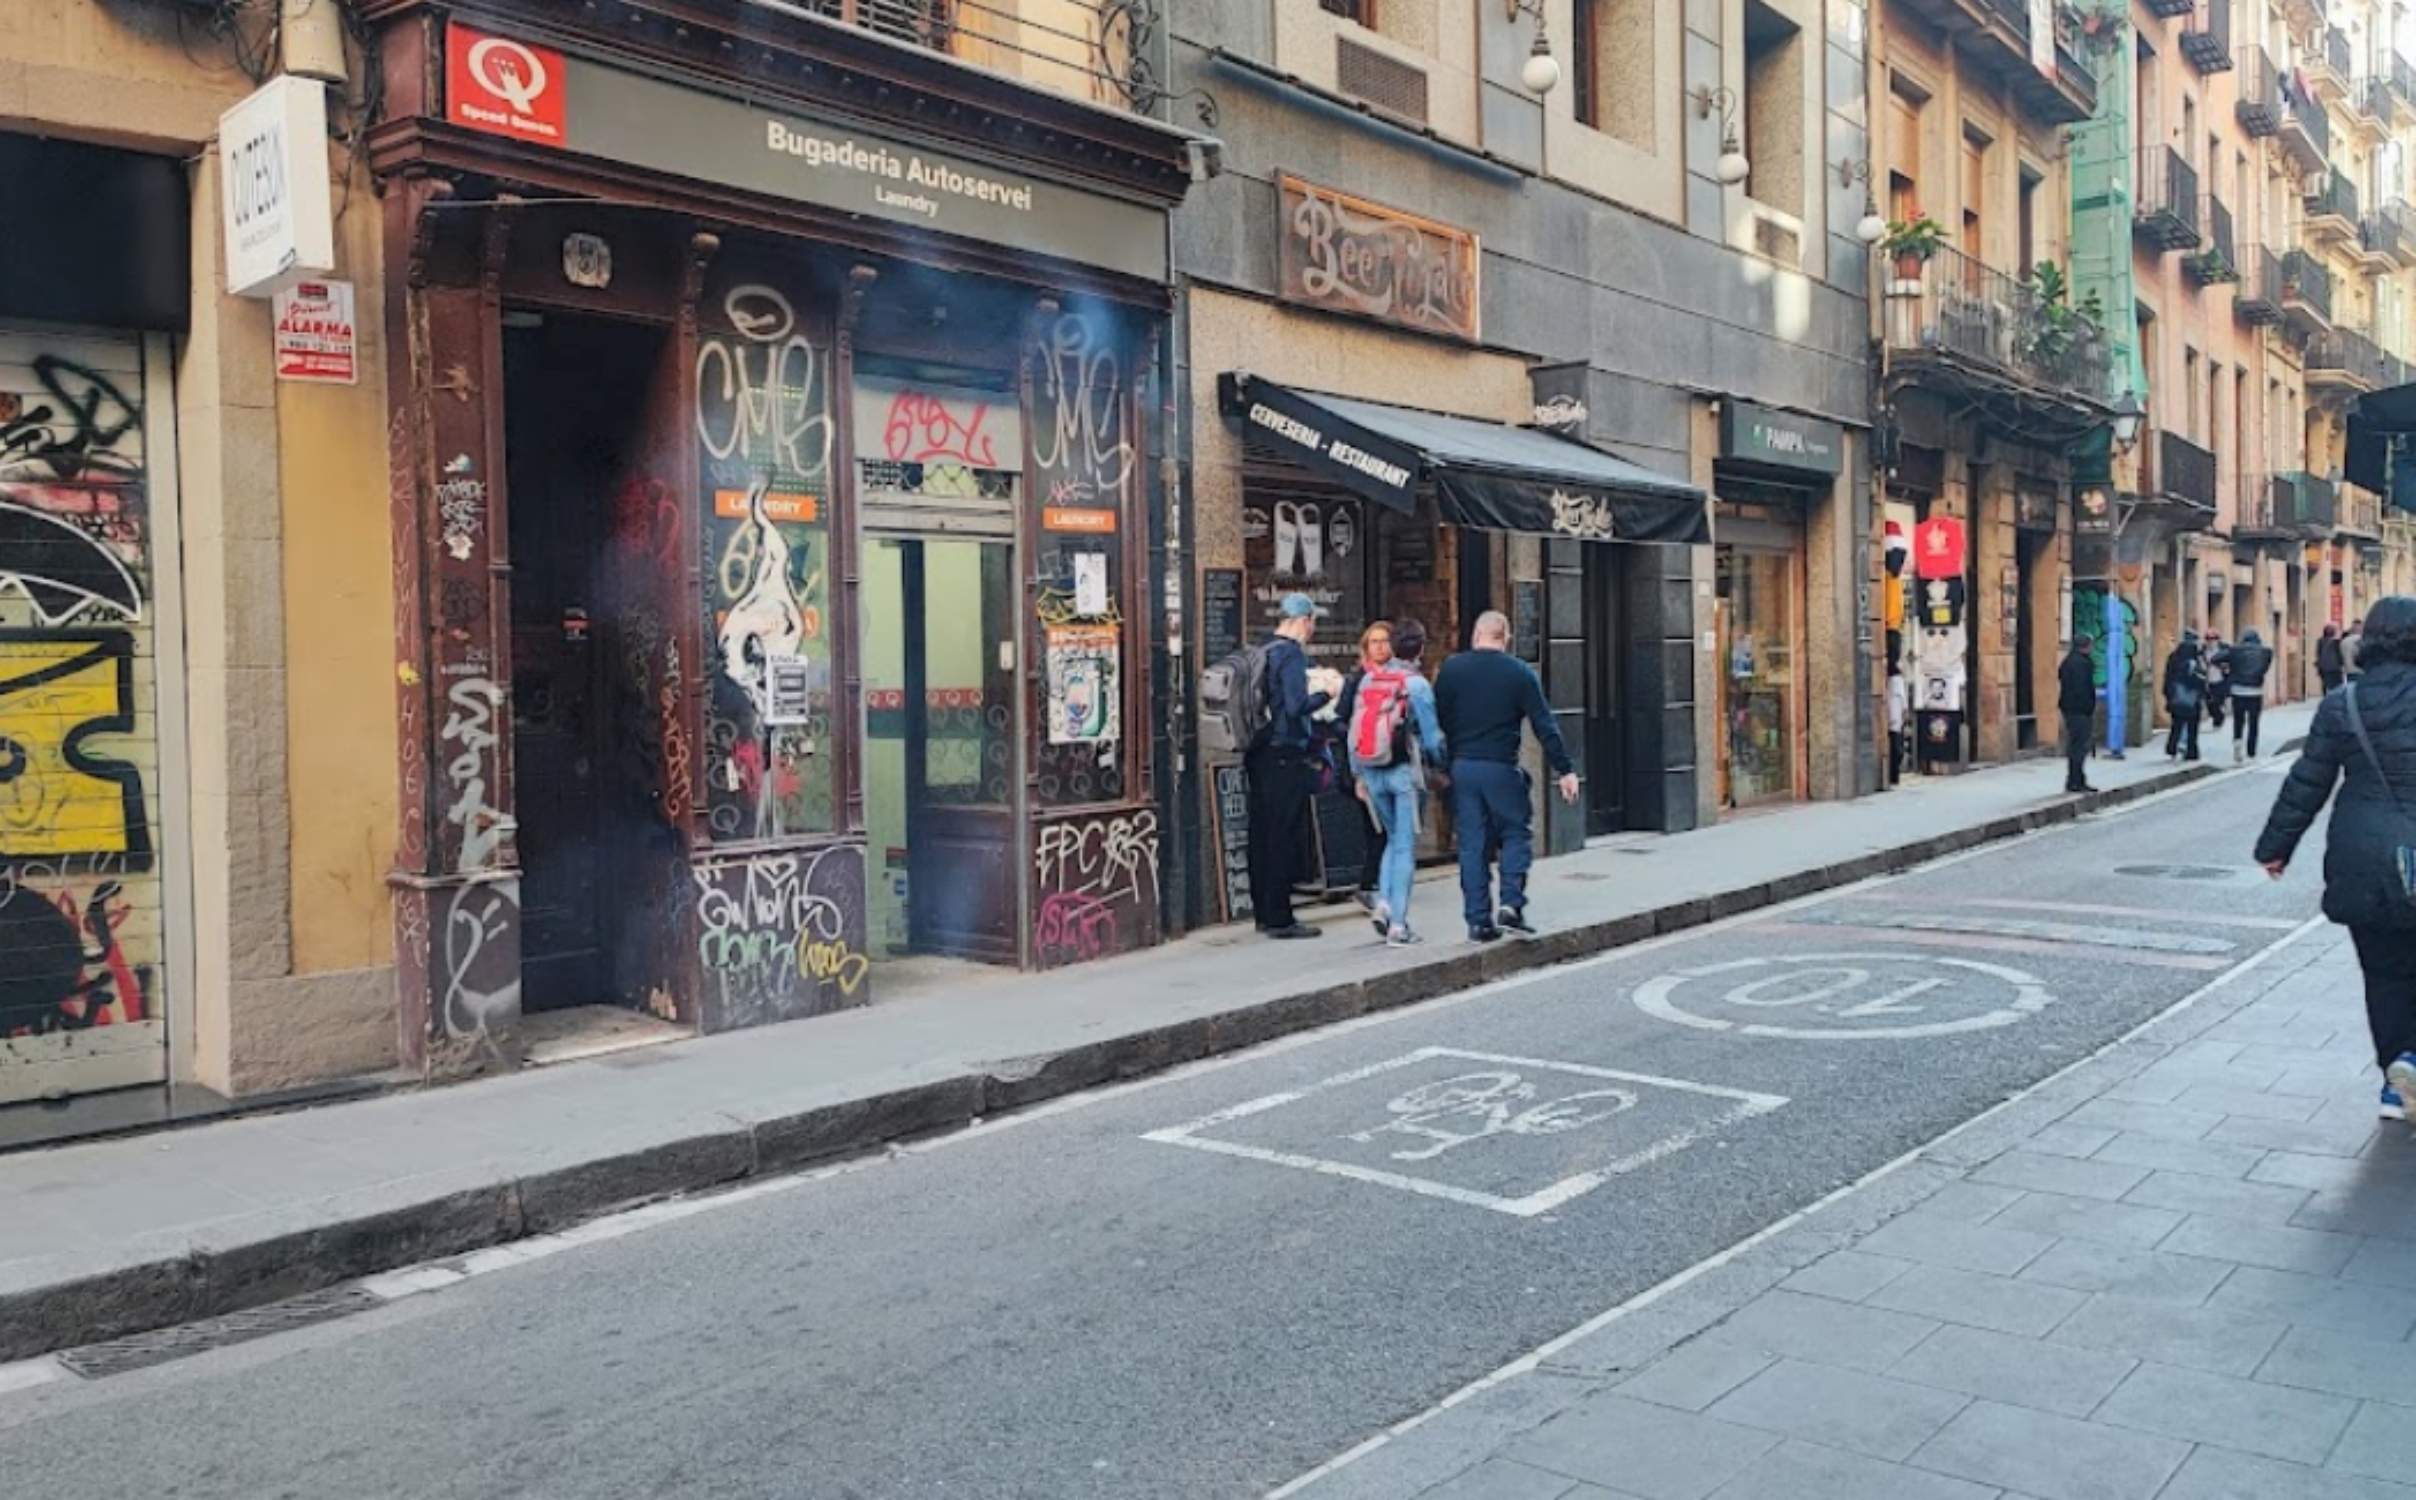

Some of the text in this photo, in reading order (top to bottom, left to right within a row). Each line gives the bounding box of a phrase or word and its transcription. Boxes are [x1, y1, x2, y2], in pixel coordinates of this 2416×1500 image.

[461, 102, 508, 125] Speed
[767, 119, 1032, 211] Bugaderia Autoservei
[875, 184, 940, 218] Laundry
[279, 319, 353, 336] ALARMA
[1250, 402, 1322, 450] CERVESERIA
[1328, 439, 1411, 489] RESTAURANT
[1053, 511, 1106, 528] LAUNDRY
